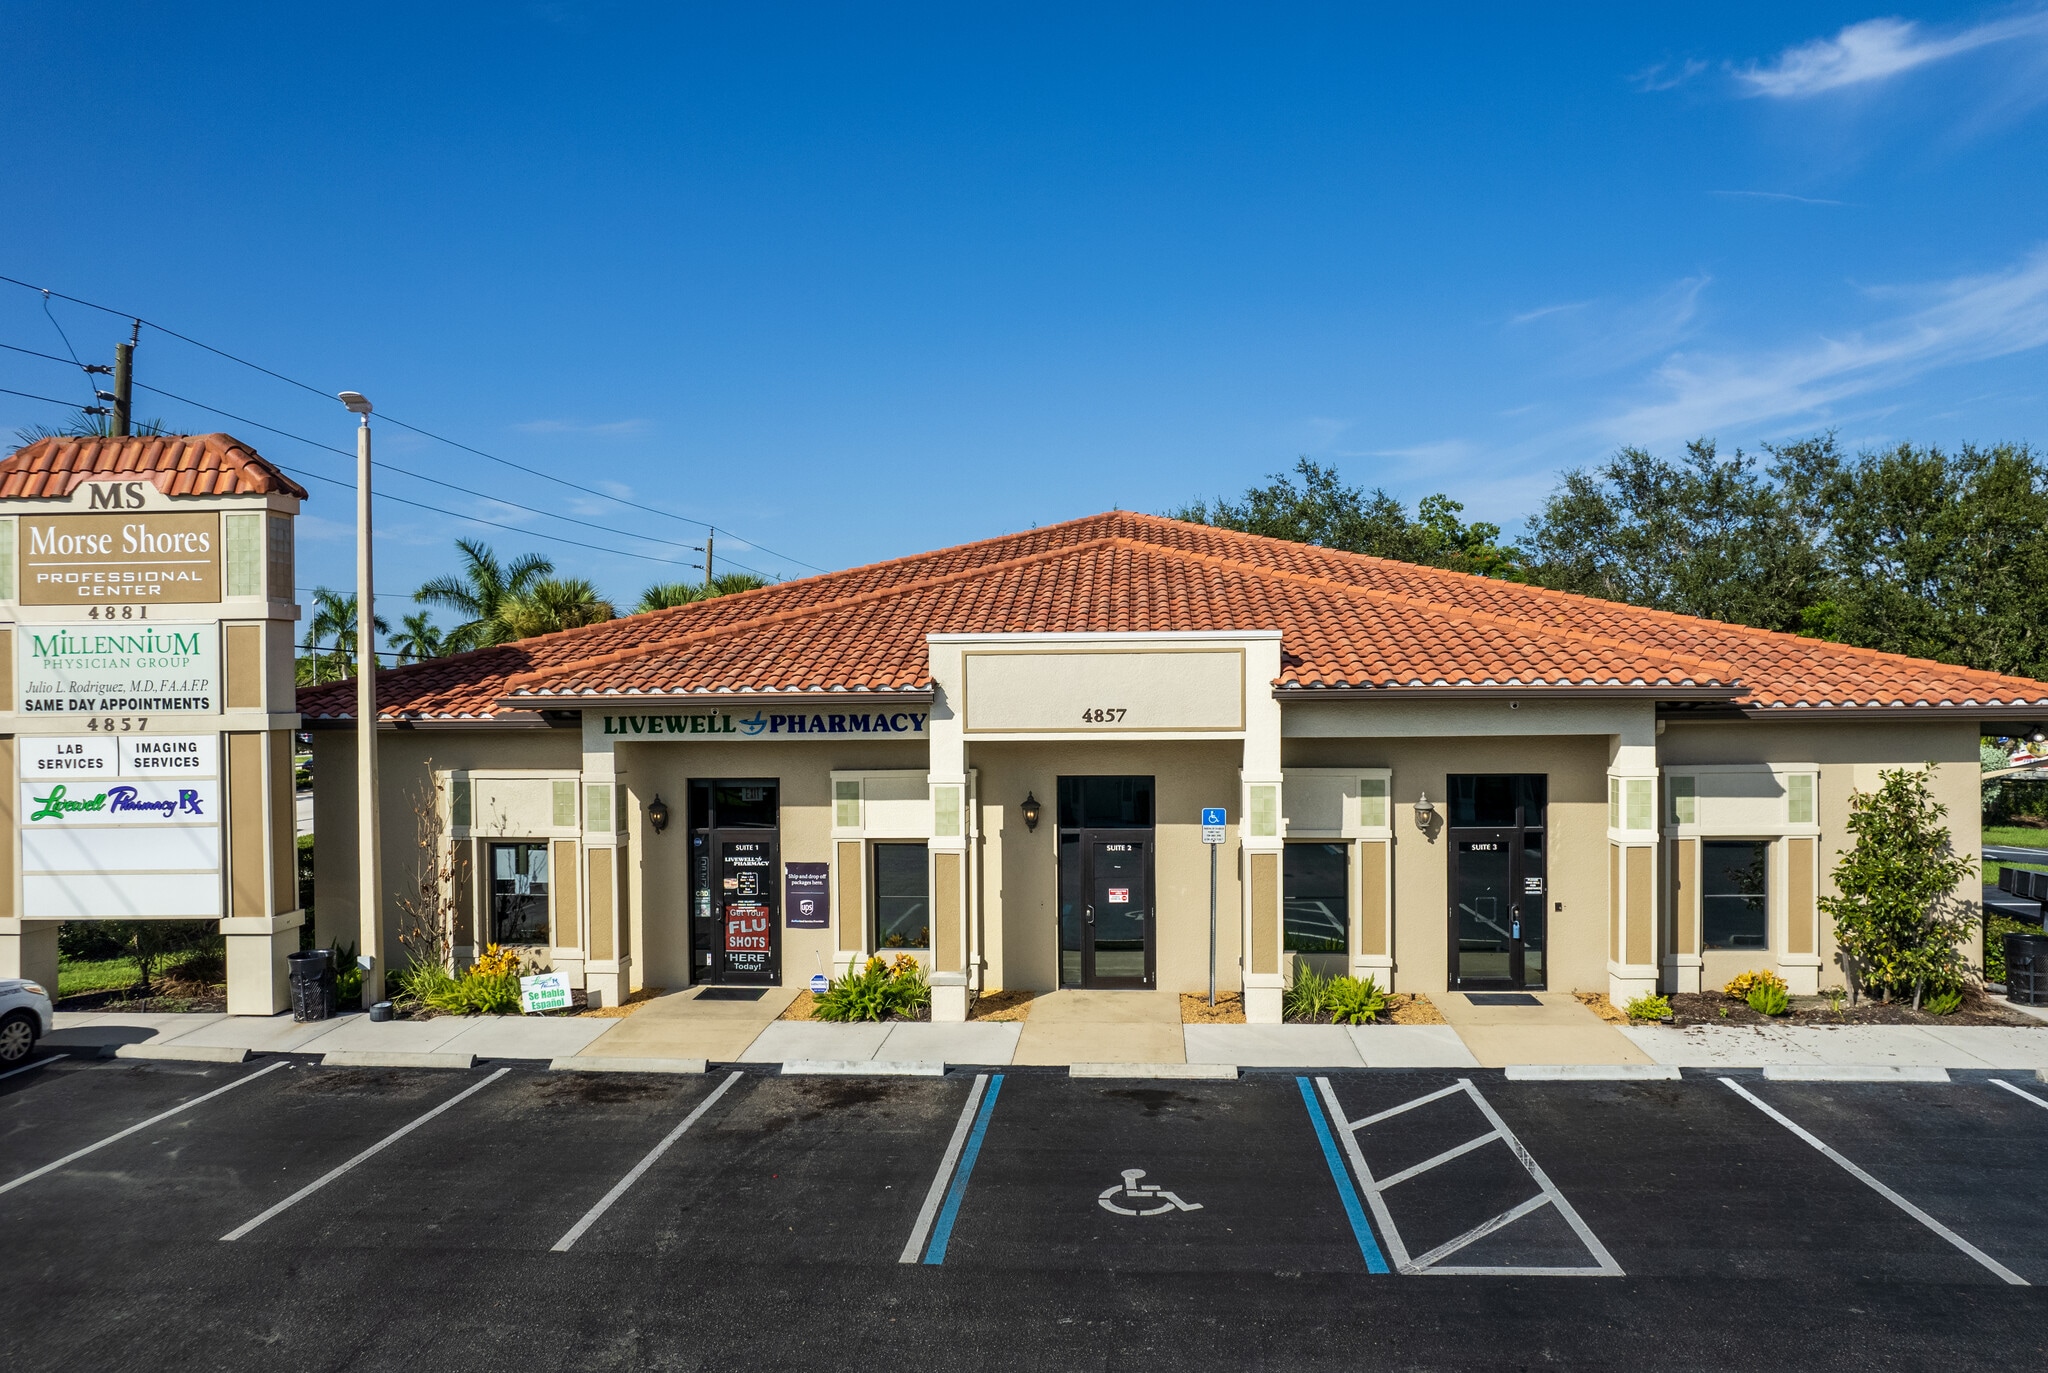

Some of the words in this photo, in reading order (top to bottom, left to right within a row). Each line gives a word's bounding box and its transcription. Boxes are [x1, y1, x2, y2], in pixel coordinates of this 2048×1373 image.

[88, 482, 145, 509] MS
[29, 526, 112, 555] Morse
[122, 523, 210, 553] Shores
[37, 571, 202, 583] PROFESSIONAL
[78, 585, 161, 596] CENTER
[88, 606, 147, 619] 4881
[43, 658, 130, 669] PHYSICIAN
[136, 657, 190, 668] GROUP
[25, 681, 53, 694] Julio
[56, 681, 66, 693] L.
[69, 680, 126, 695] Rodriguez,
[25, 699, 63, 711] SAME
[69, 699, 96, 711] DAY
[100, 697, 210, 710] APPOINTMENTS
[1082, 708, 1127, 723] 4857
[87, 717, 148, 731] 4857
[604, 715, 736, 734] LIVEWELL
[769, 713, 927, 733] PHARMACY
[57, 744, 83, 754] LAB
[135, 742, 197, 753] IMAGING
[38, 758, 103, 769] SERVICES
[134, 757, 199, 767] SERVICES
[108, 786, 177, 818] Pharmacy
[729, 918, 766, 934] FLU
[729, 936, 766, 948] SHOTS
[729, 953, 765, 962] HERE
[734, 962, 762, 971] Today!
[528, 992, 539, 1000] Se
[541, 989, 565, 998] Habla
[531, 998, 564, 1010] Español
